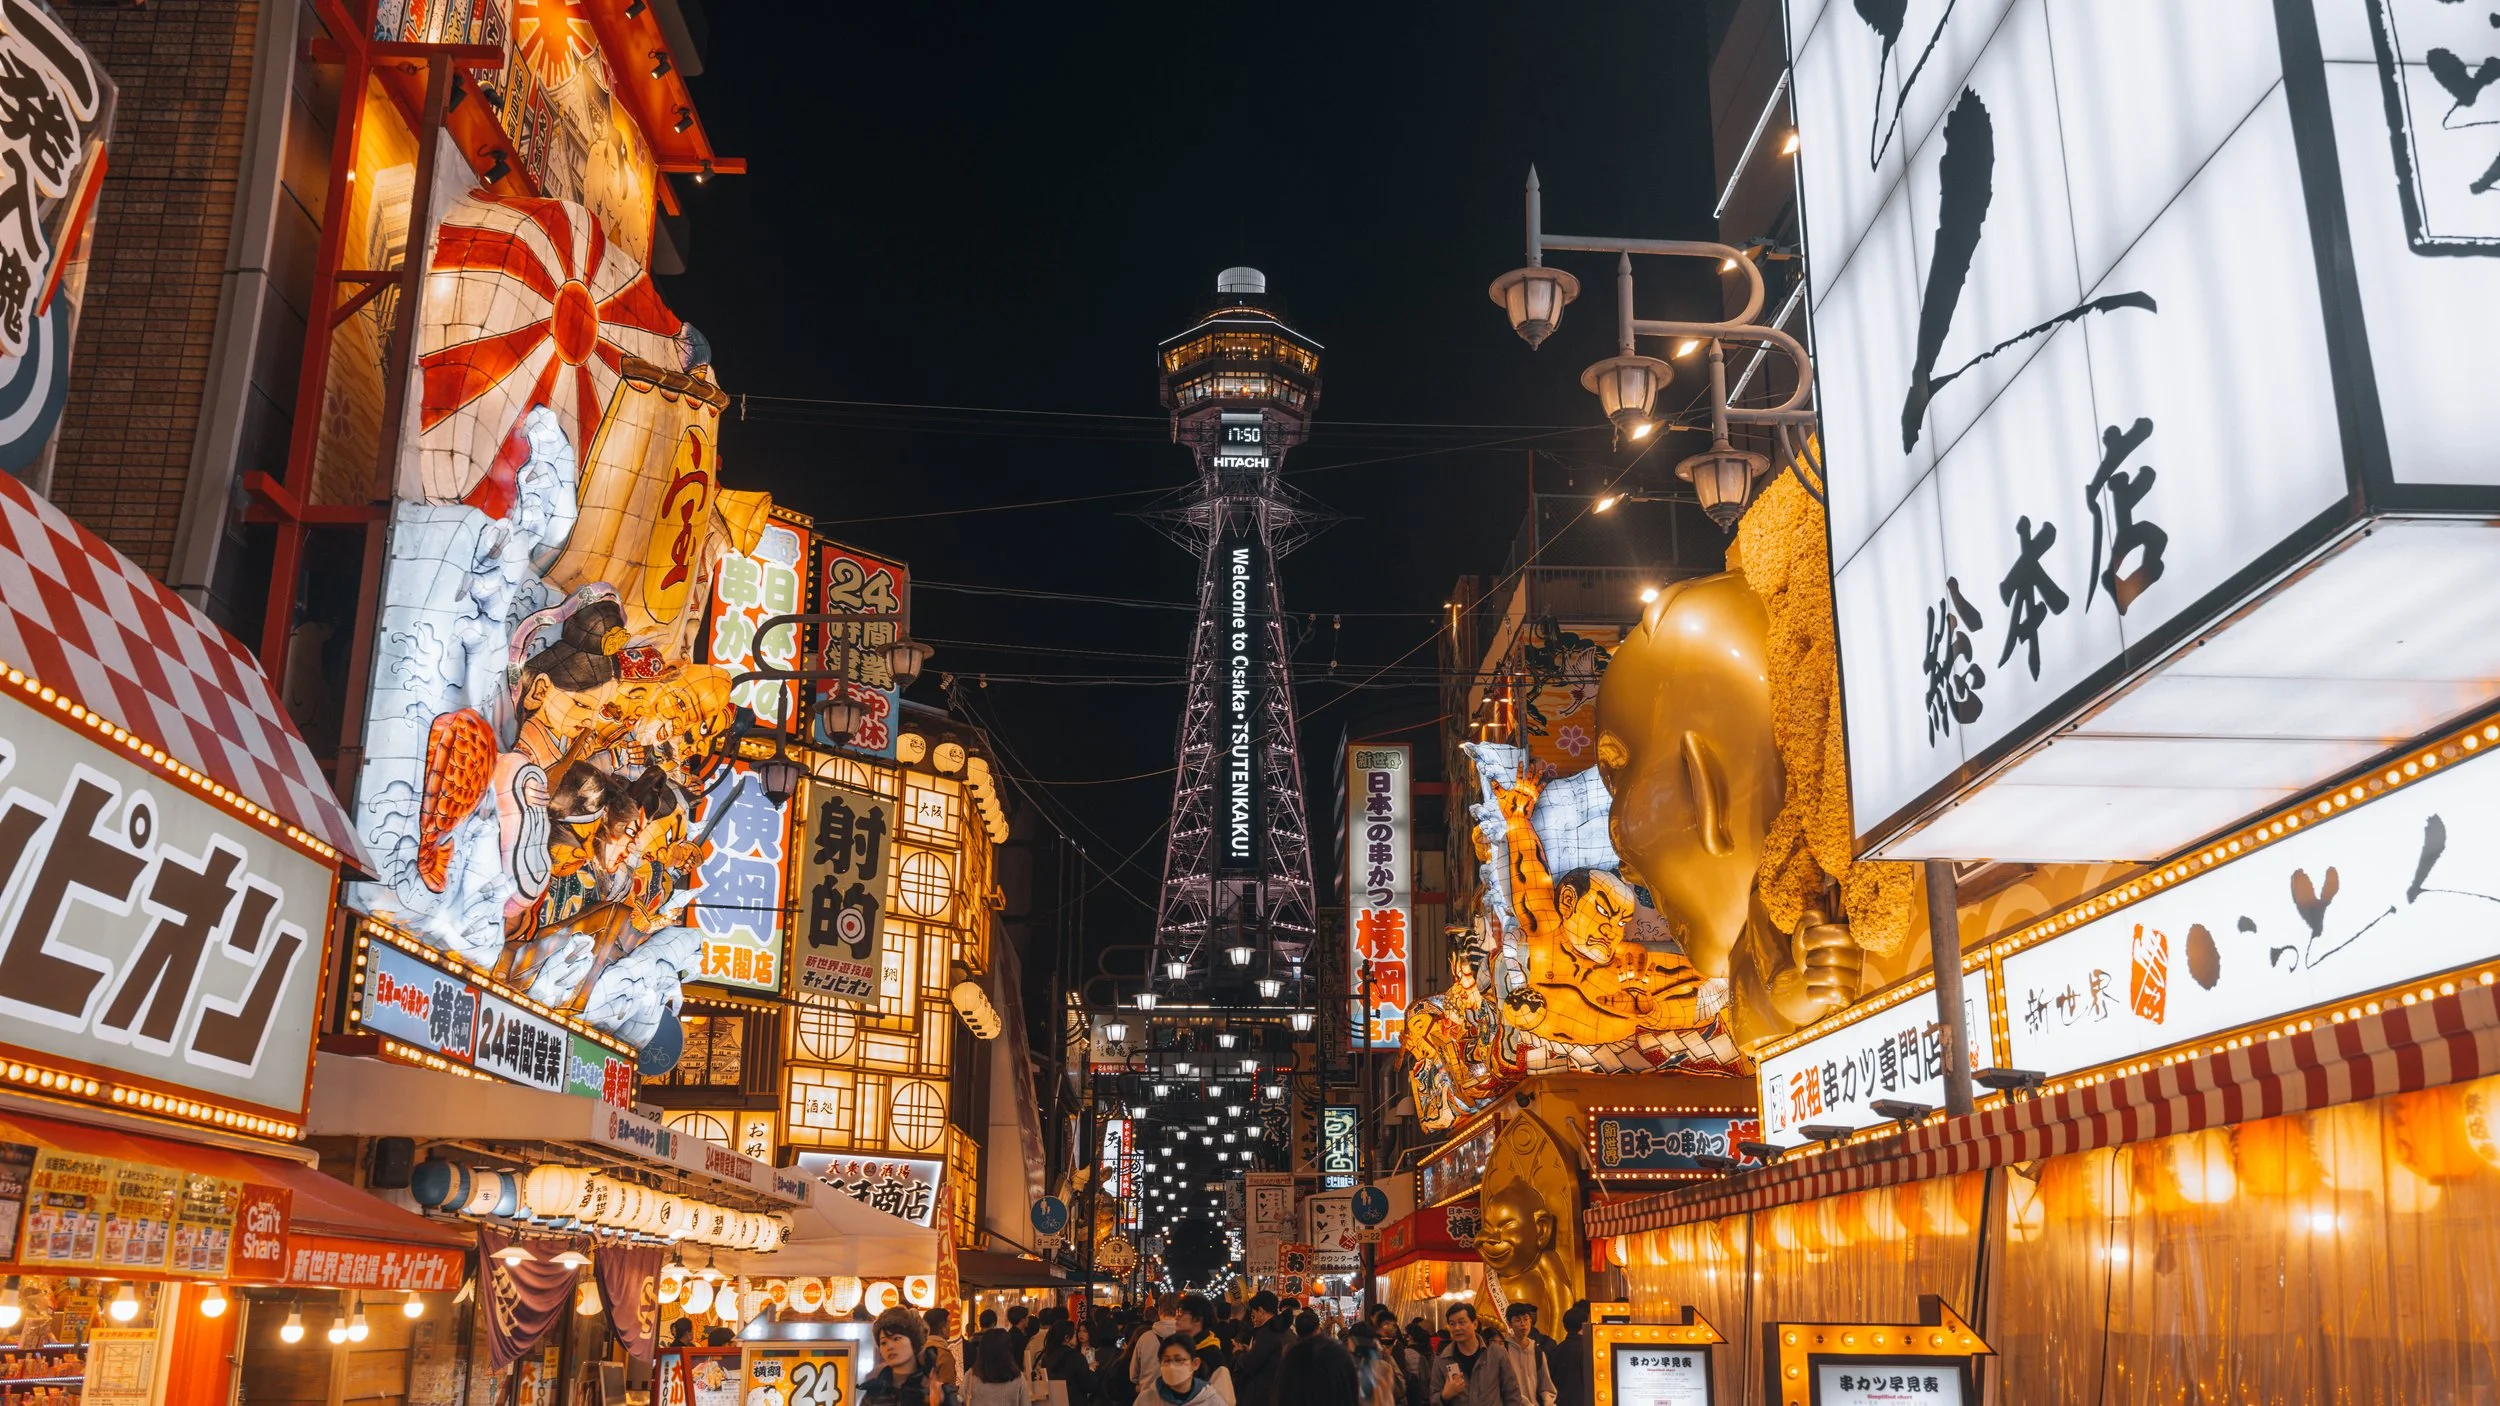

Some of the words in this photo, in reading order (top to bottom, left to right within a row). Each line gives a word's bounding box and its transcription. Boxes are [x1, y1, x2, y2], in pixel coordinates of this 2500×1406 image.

[1228, 427, 1260, 442] 17:50
[1214, 457, 1269, 468] HITACHI
[1232, 548, 1250, 629] Welcome
[1923, 417, 2168, 748] 総本店
[1232, 634, 1248, 651] to
[1356, 751, 1402, 770] 新世界
[919, 803, 944, 819] 大阪
[1367, 772, 1394, 907] 日本一の串かつ
[697, 768, 783, 945] 横綱
[808, 795, 886, 960] 射的
[804, 955, 873, 980] 新世界遊技場
[1356, 909, 1405, 1011] 横綱
[802, 970, 873, 997] チャンピオン
[376, 972, 430, 1020] 日本一の串かつ
[429, 979, 476, 1056] 横綱
[2025, 968, 2120, 1034] 新世界
[477, 1007, 562, 1086] 24時間営業
[807, 1098, 834, 1115] 酒処
[1620, 1130, 1725, 1158] 日本一の串かつ
[247, 1206, 281, 1234] Can't
[243, 1232, 280, 1260] Share
[1036, 1237, 1060, 1247] 9-22
[292, 1249, 379, 1285] 新世界遊技場
[381, 1252, 448, 1290] チャンピオン
[753, 1365, 781, 1378] 横綱
[1629, 1356, 1692, 1368] 串カツ早見表
[792, 1362, 842, 1406] 24
[1839, 1375, 1939, 1393] 串カツ早見表
